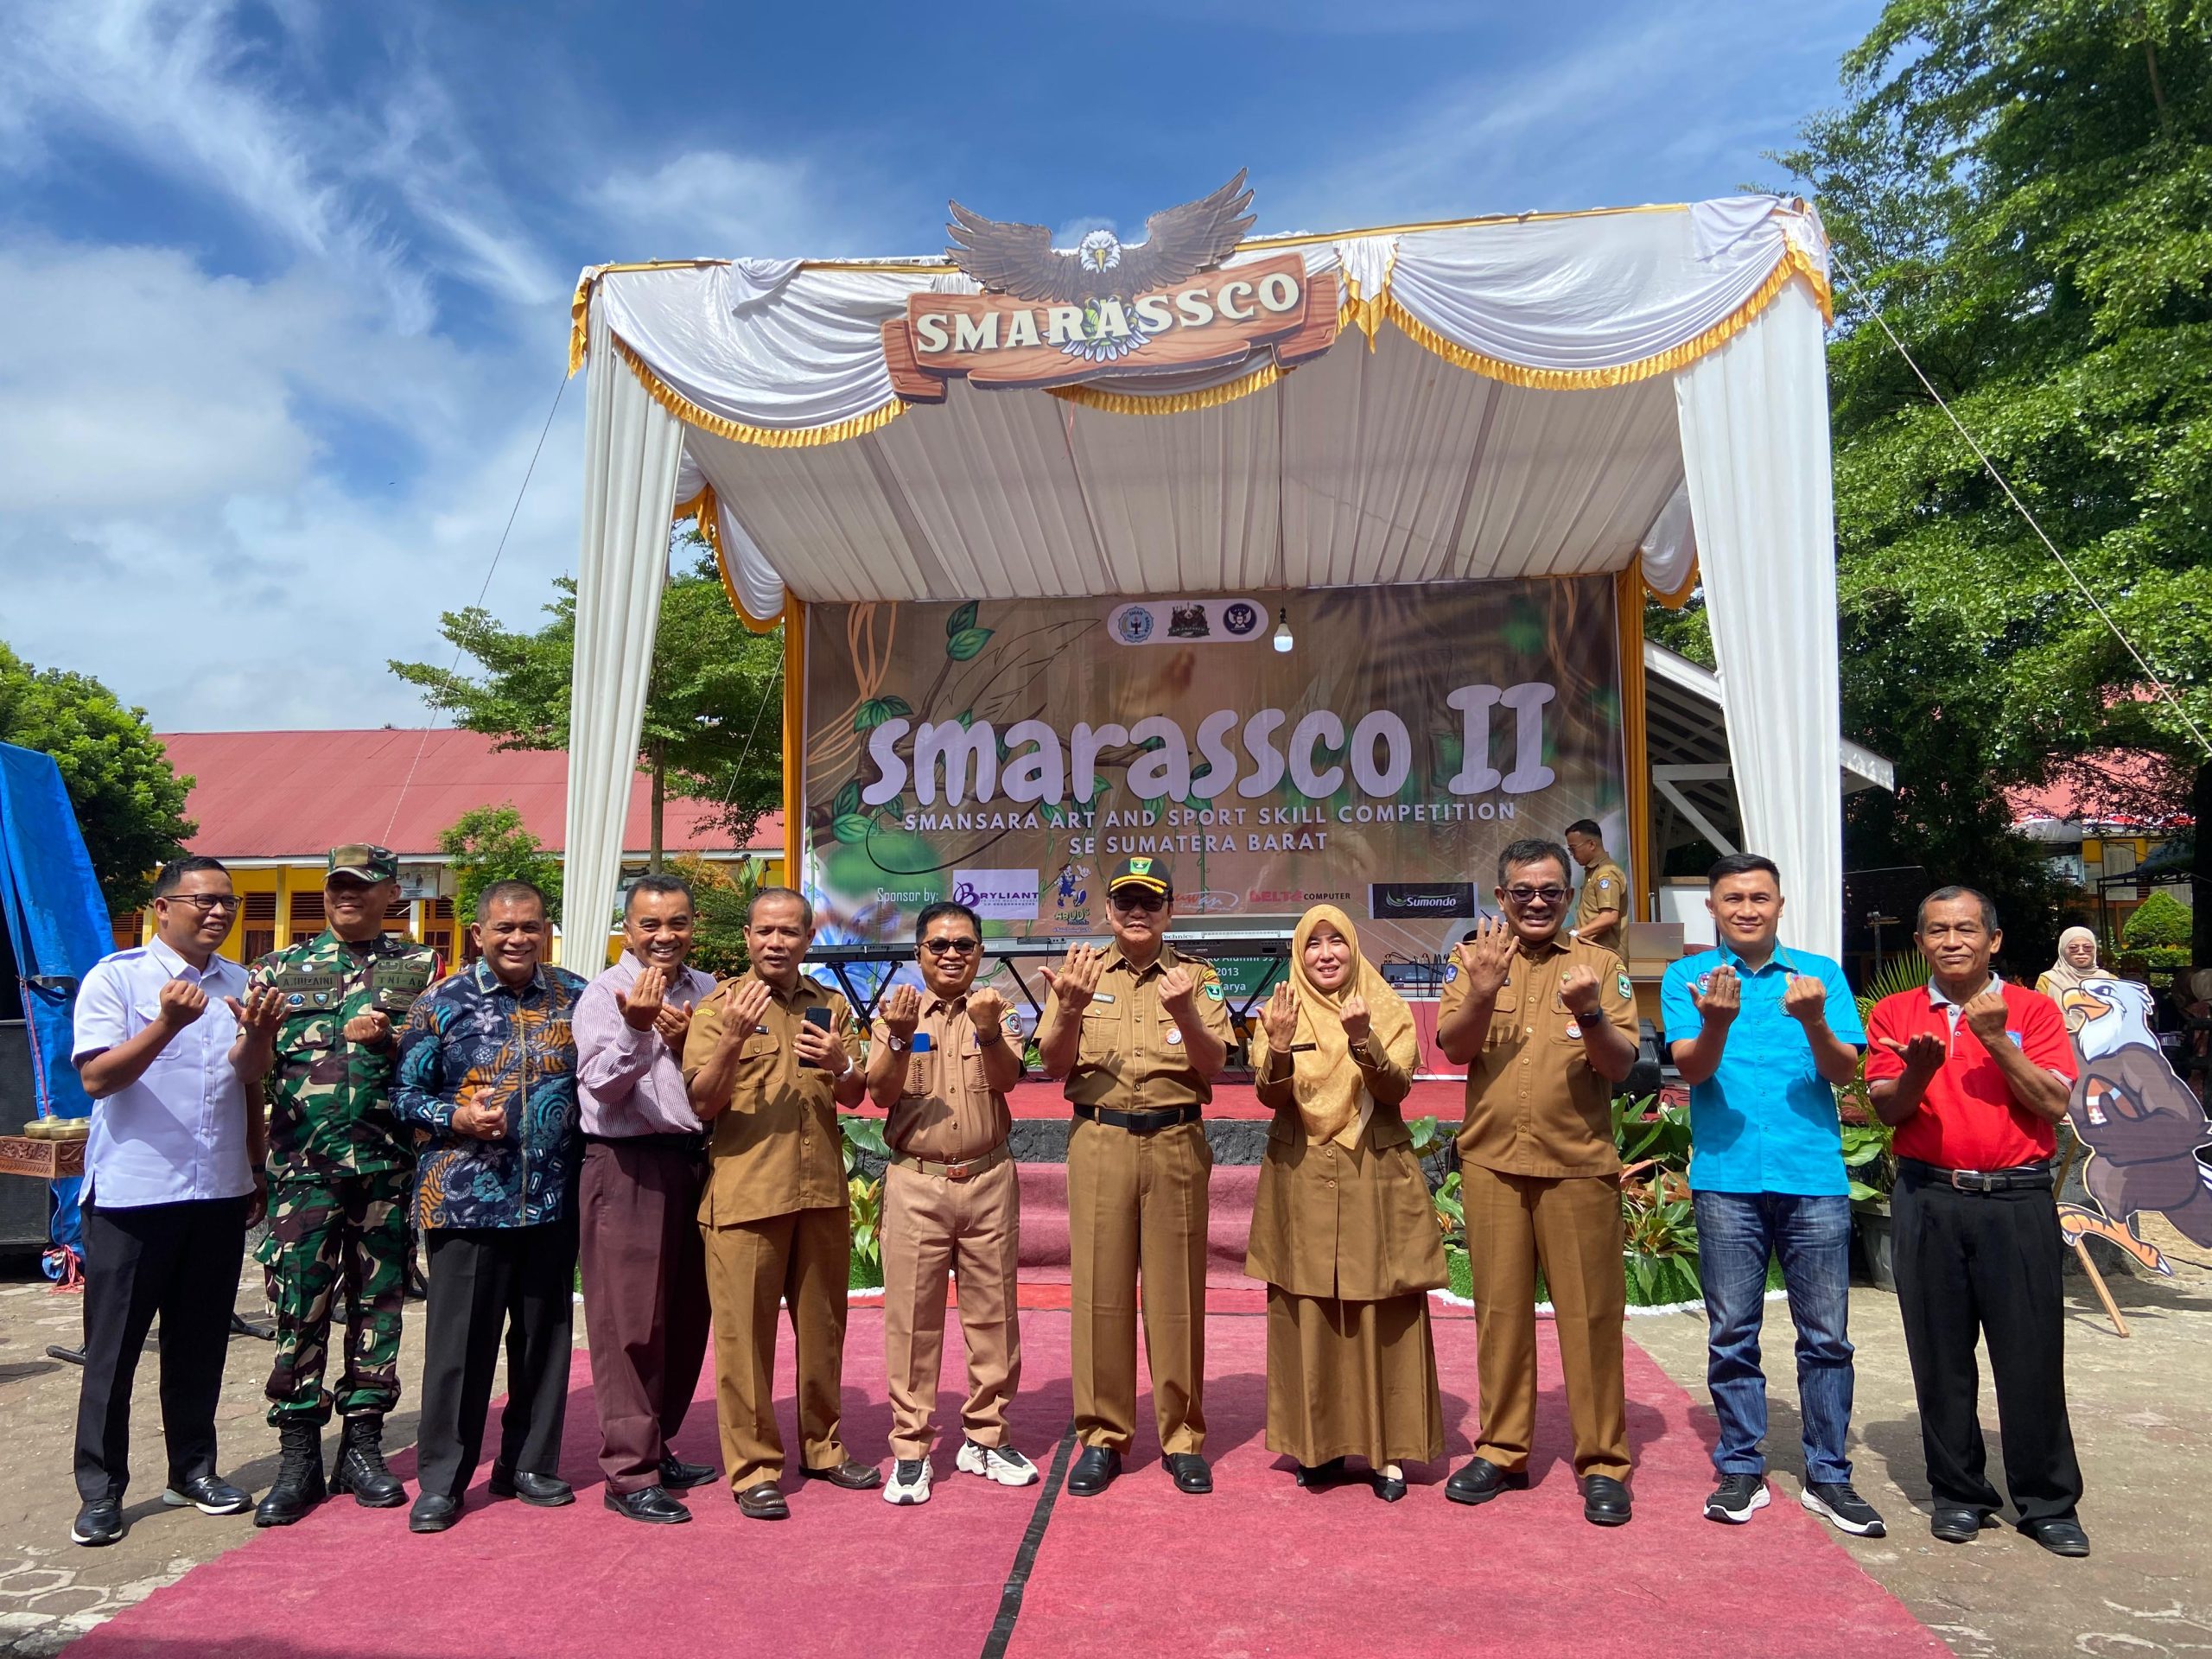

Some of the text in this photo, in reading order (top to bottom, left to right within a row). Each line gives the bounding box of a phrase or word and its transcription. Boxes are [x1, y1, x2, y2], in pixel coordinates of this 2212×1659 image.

[917, 272, 1300, 353] SMARASSCO
[1446, 682, 1556, 796] II
[904, 802, 1516, 831] SMANSARA ART AND SPORT SKILL COMPETITION
[1069, 832, 1328, 855] SE SUMATERA BARAT
[877, 887, 939, 905] Sponsor by:
[1406, 897, 1457, 906] Sumondo
[1216, 967, 1240, 976] 2013
[1221, 982, 1246, 993] arya
